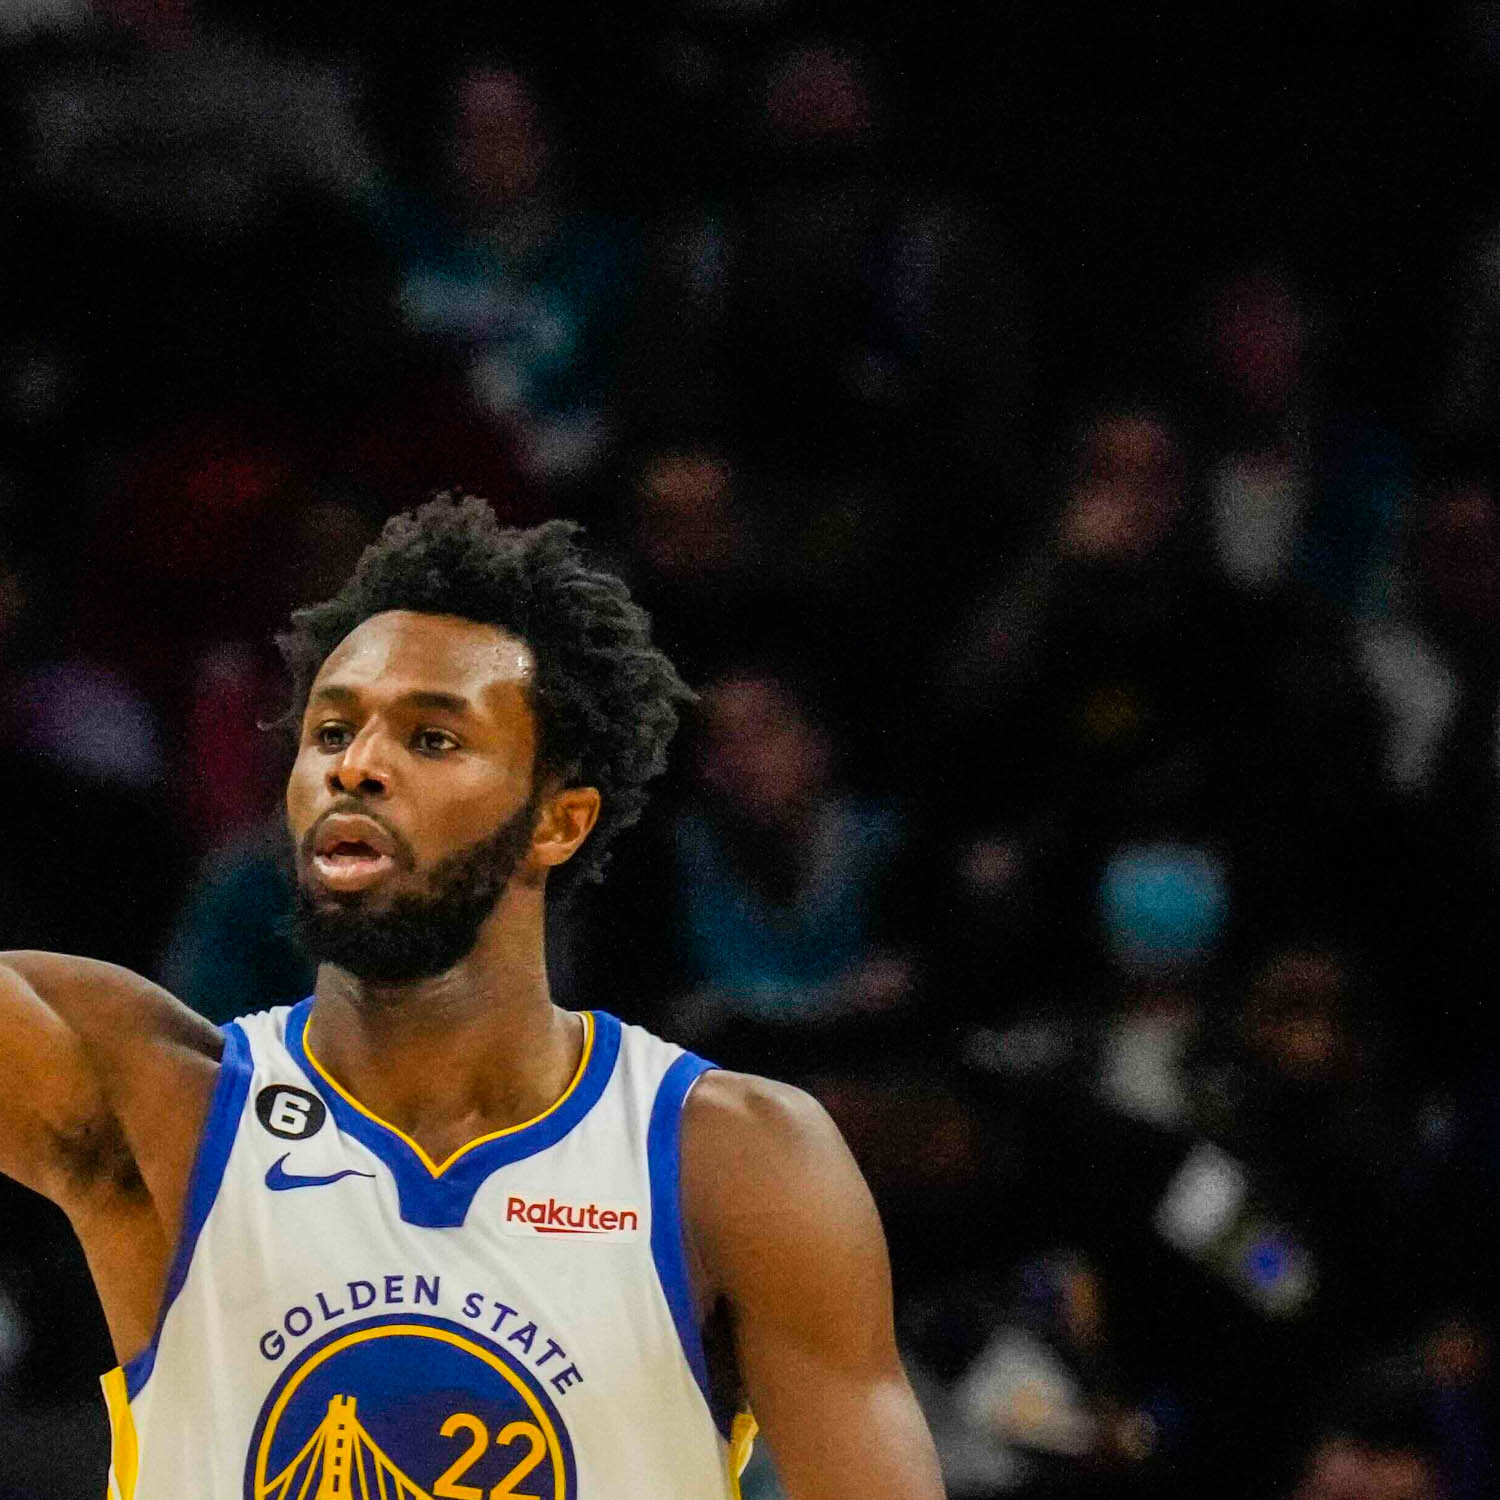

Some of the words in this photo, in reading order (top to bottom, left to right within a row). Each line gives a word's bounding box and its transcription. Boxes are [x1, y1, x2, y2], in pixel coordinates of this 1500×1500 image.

[268, 1092, 311, 1135] 6
[506, 1197, 638, 1232] Rakuten
[259, 1275, 441, 1361] GOLDEN
[463, 1293, 584, 1396] STATE
